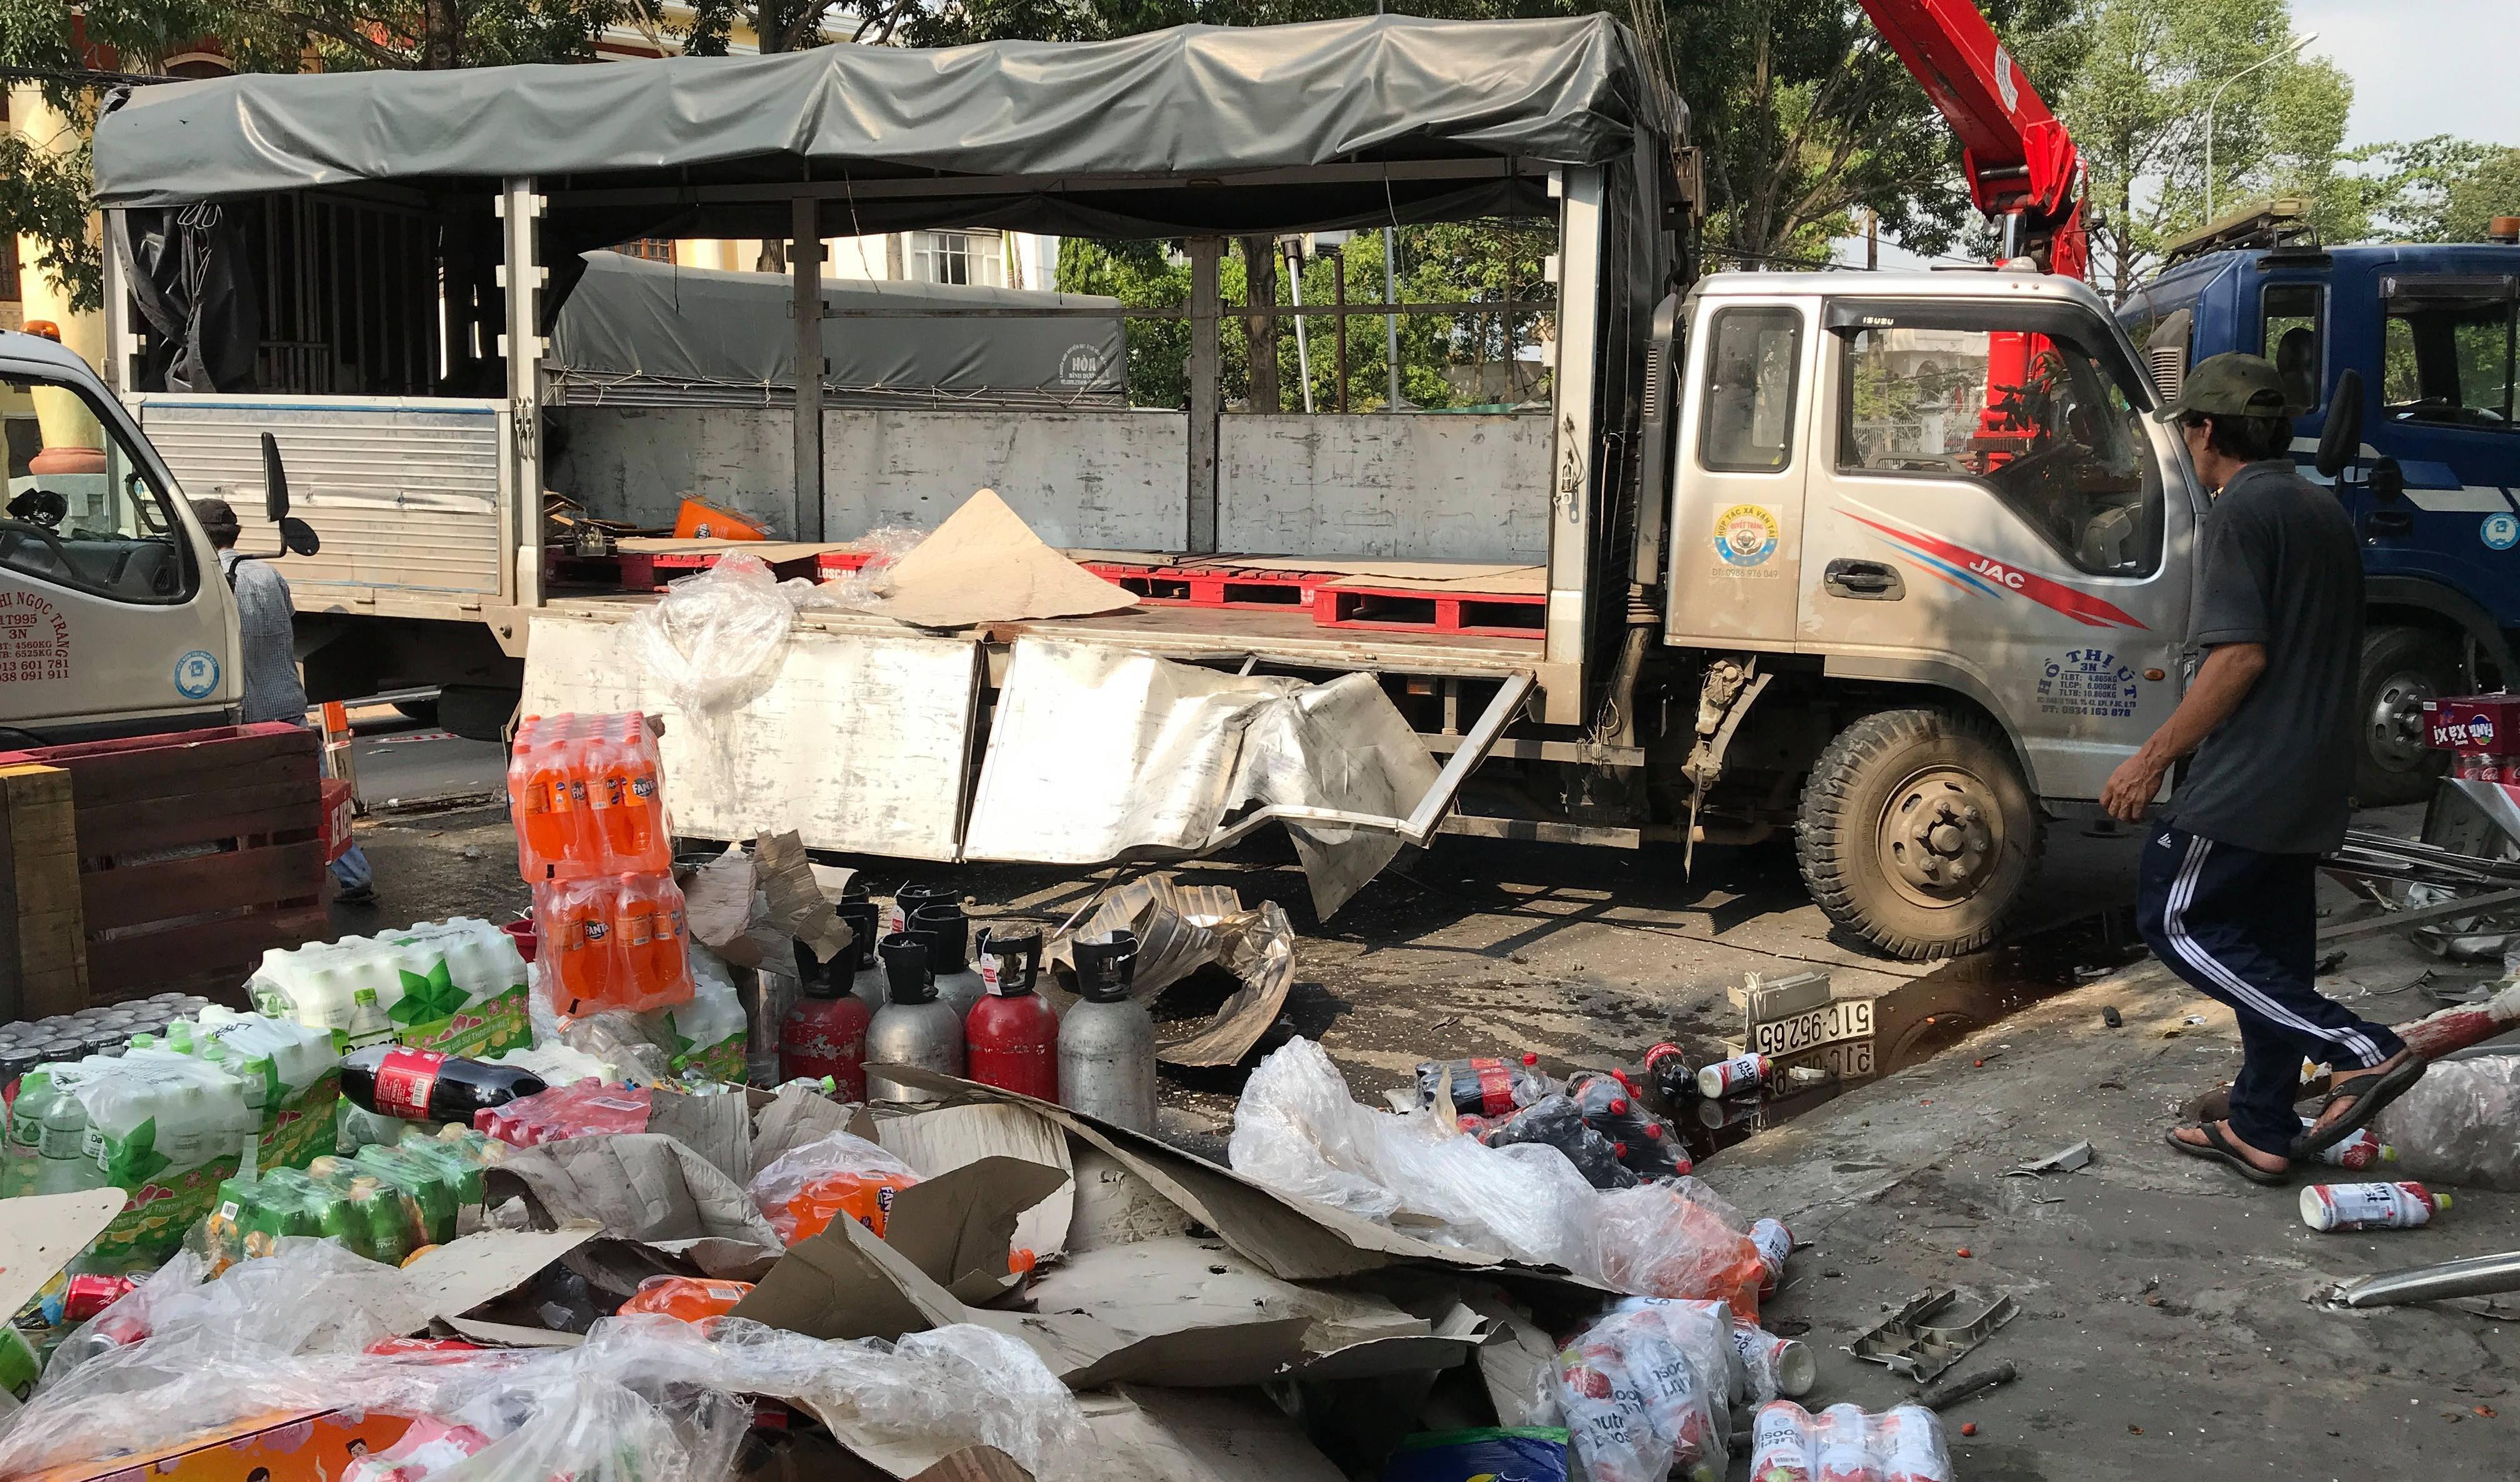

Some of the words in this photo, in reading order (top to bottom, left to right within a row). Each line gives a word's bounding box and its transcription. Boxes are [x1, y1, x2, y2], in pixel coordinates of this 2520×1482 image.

[1863, 317, 1894, 326] ISUZU
[1072, 354, 1096, 371] HÒA
[1969, 559, 2025, 589] JAC
[17, 592, 53, 615] NGỌC
[50, 613, 69, 657] TRANG
[9, 629, 28, 639] 3N
[15, 640, 52, 649] 4560KG
[15, 649, 52, 658] 6525KG
[2066, 649, 2115, 669] THỊ
[21, 660, 42, 670] 601
[48, 659, 69, 669] 781
[2081, 663, 2097, 672] 3N
[21, 671, 42, 681] 091
[48, 669, 69, 679] 911
[2091, 707, 2108, 716] 163
[2111, 709, 2131, 717] 878
[2469, 723, 2494, 737] FANTA
[1760, 1003, 1869, 1056] 51C-952.65
